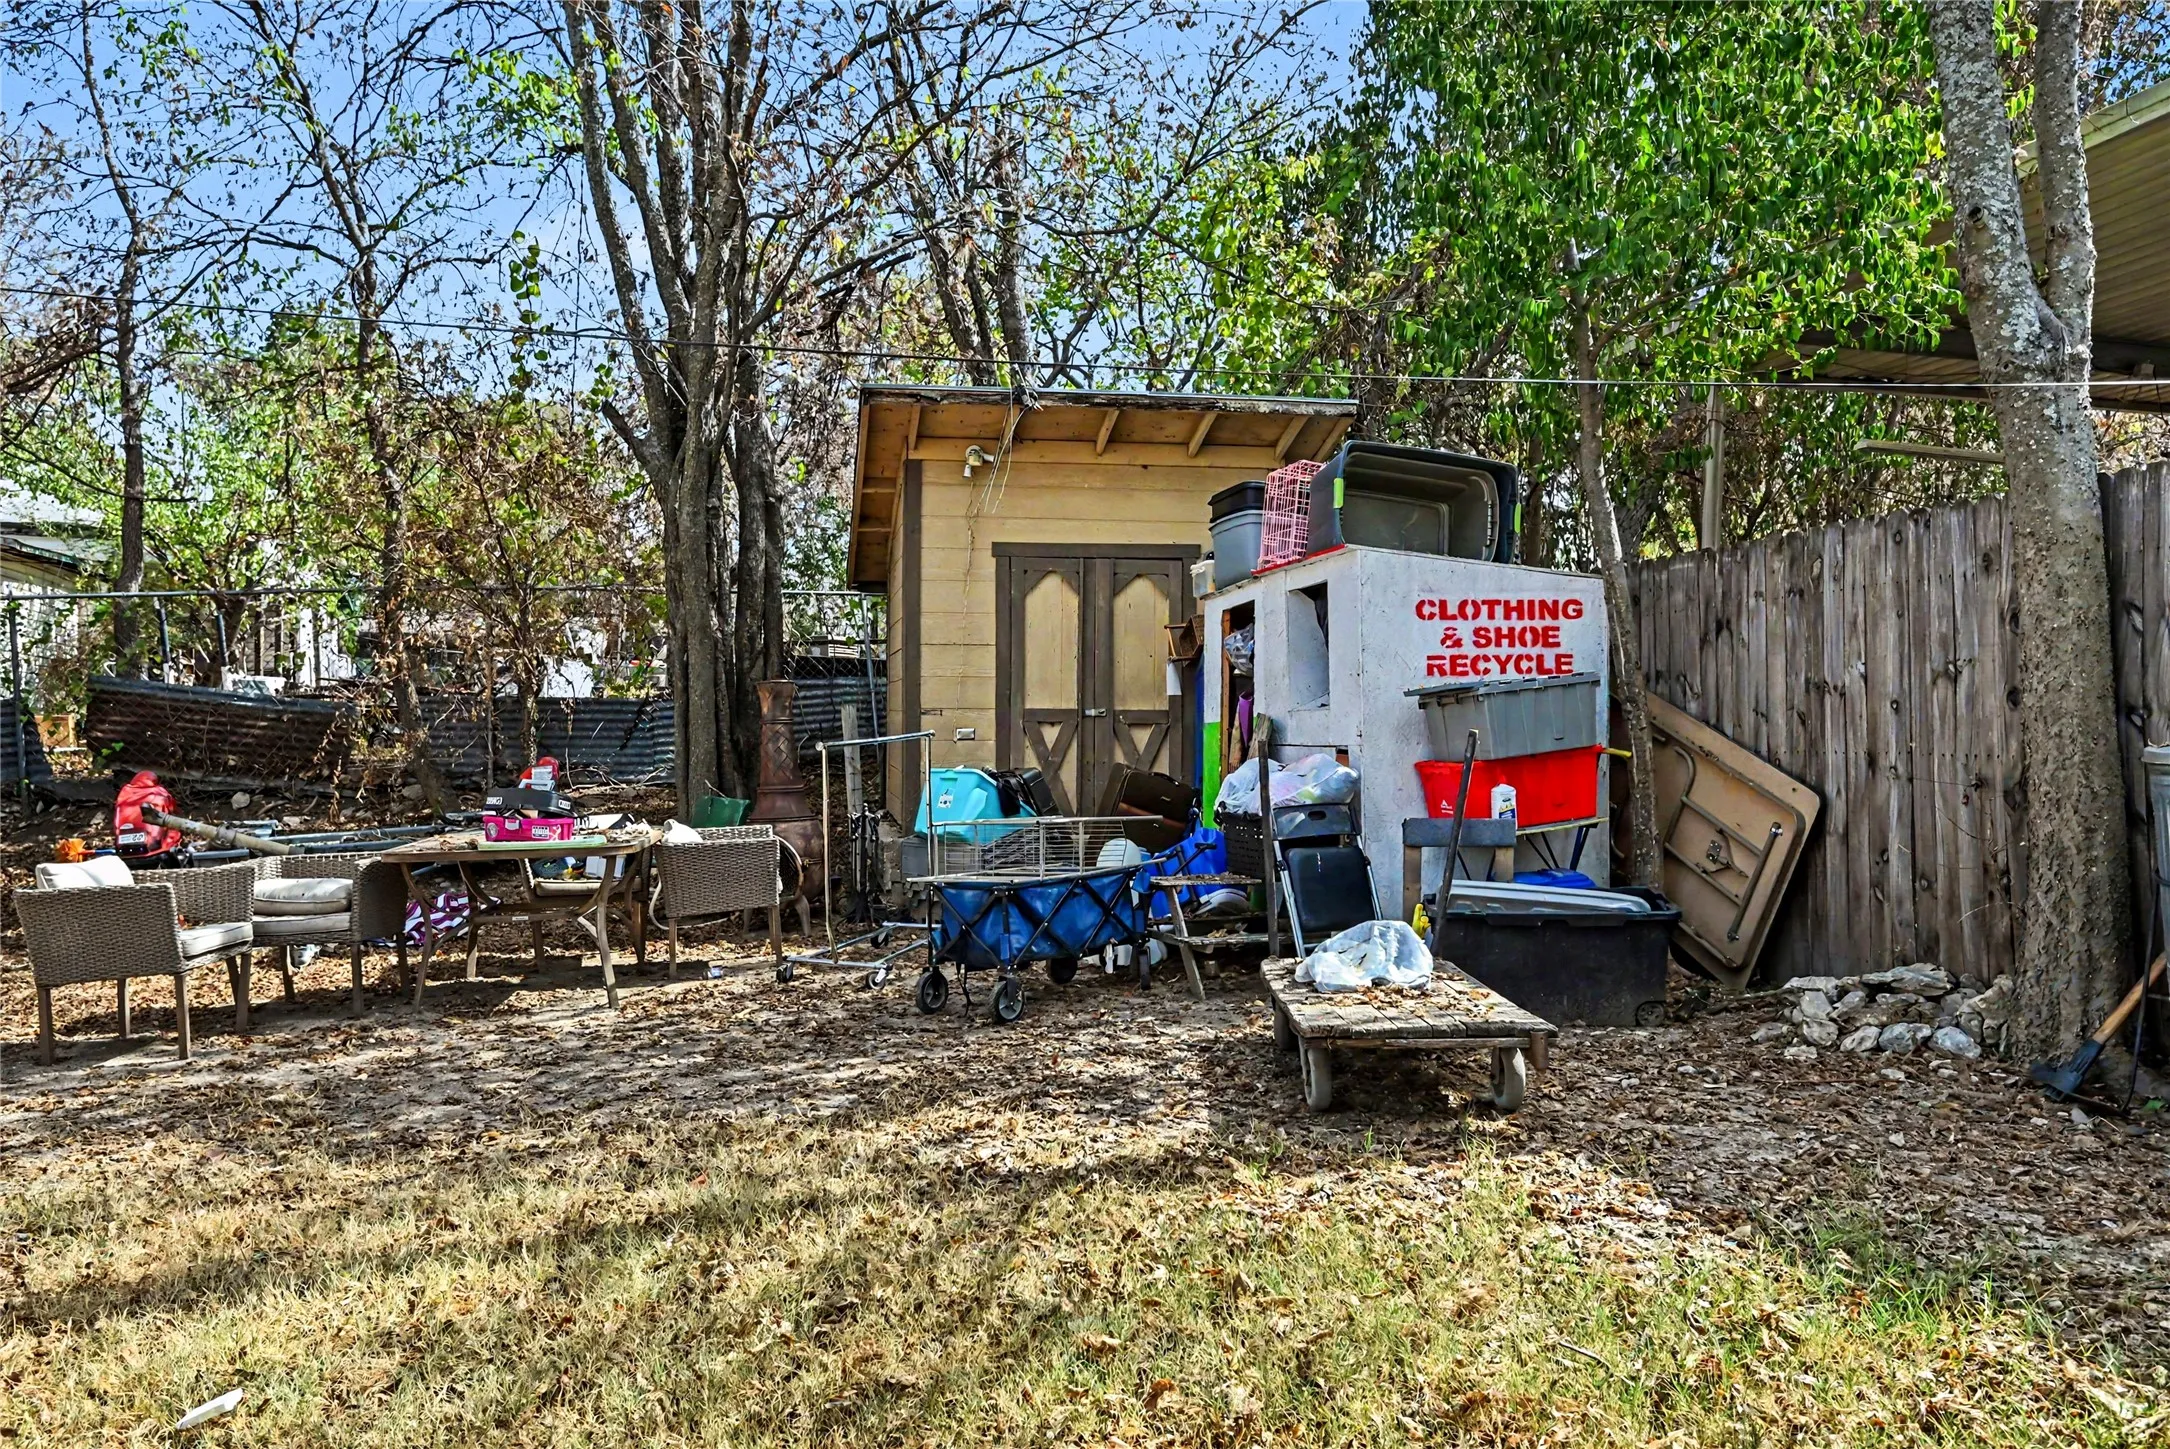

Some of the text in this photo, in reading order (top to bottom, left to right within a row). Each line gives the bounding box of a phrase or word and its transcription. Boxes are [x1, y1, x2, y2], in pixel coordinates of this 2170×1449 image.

[1416, 599, 1583, 621] CLOTHING
[1440, 625, 1561, 649] & SHOE
[1427, 653, 1574, 677] RECYCLE
